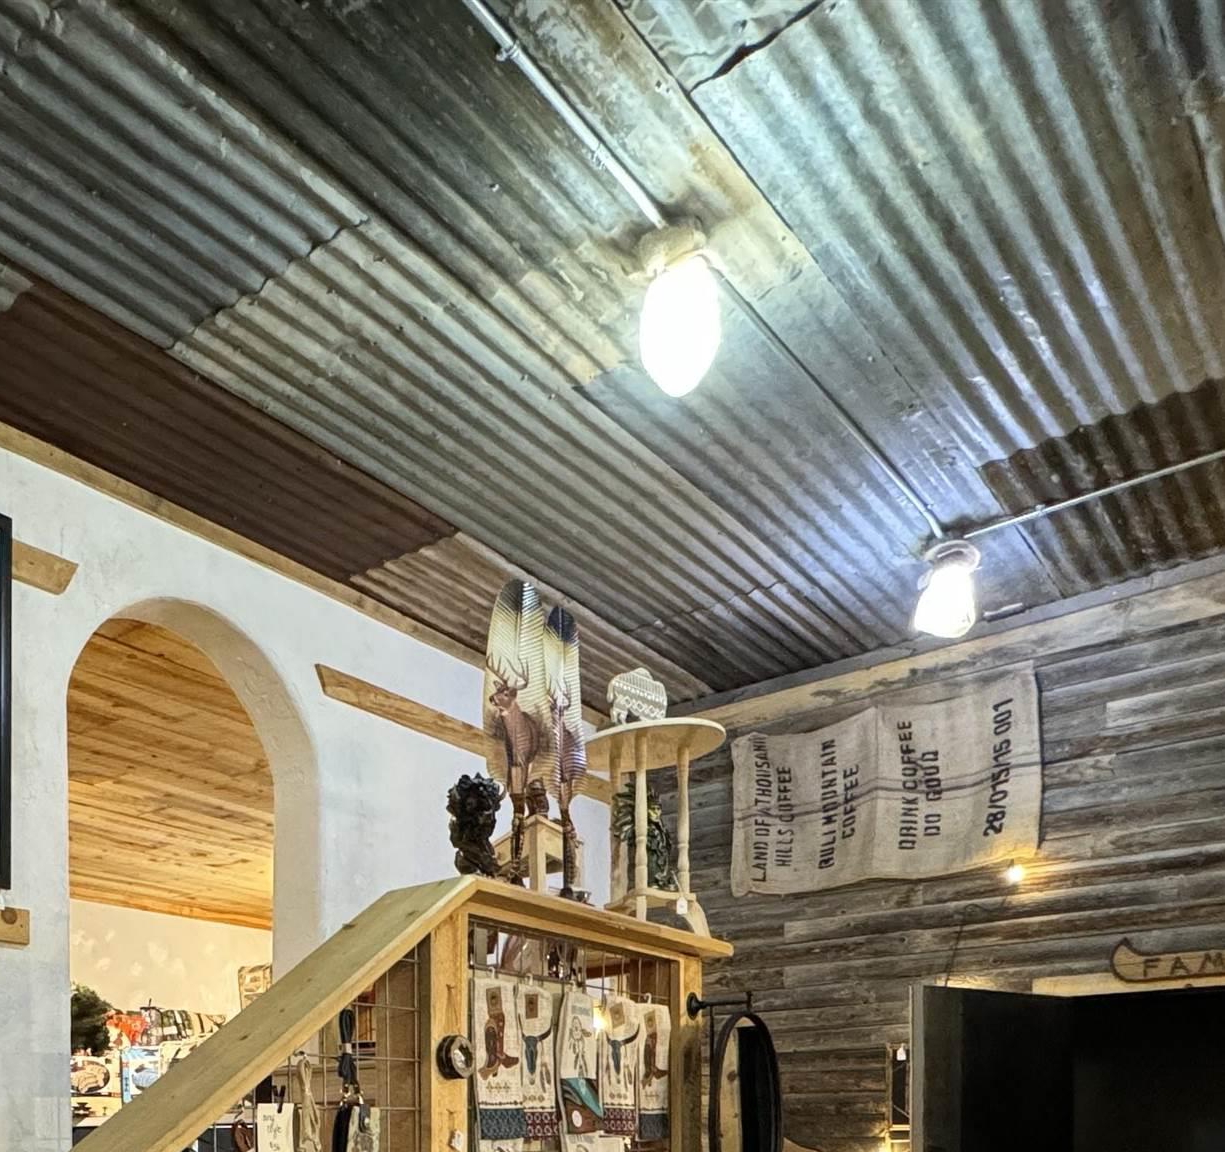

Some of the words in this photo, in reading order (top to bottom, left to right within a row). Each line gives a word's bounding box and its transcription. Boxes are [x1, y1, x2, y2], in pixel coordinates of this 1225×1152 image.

[992, 698, 1014, 736] 001
[897, 720, 918, 791] COFFEE
[921, 750, 943, 802] GOOD
[776, 766, 795, 823] COFFEE
[820, 739, 839, 826] MOUNTAIN
[841, 764, 859, 840] COFFEE
[754, 818, 772, 837] OF
[775, 828, 794, 867] HILLS
[897, 796, 919, 850] DRINK
[923, 813, 942, 836] DO
[751, 841, 769, 882] LAND
